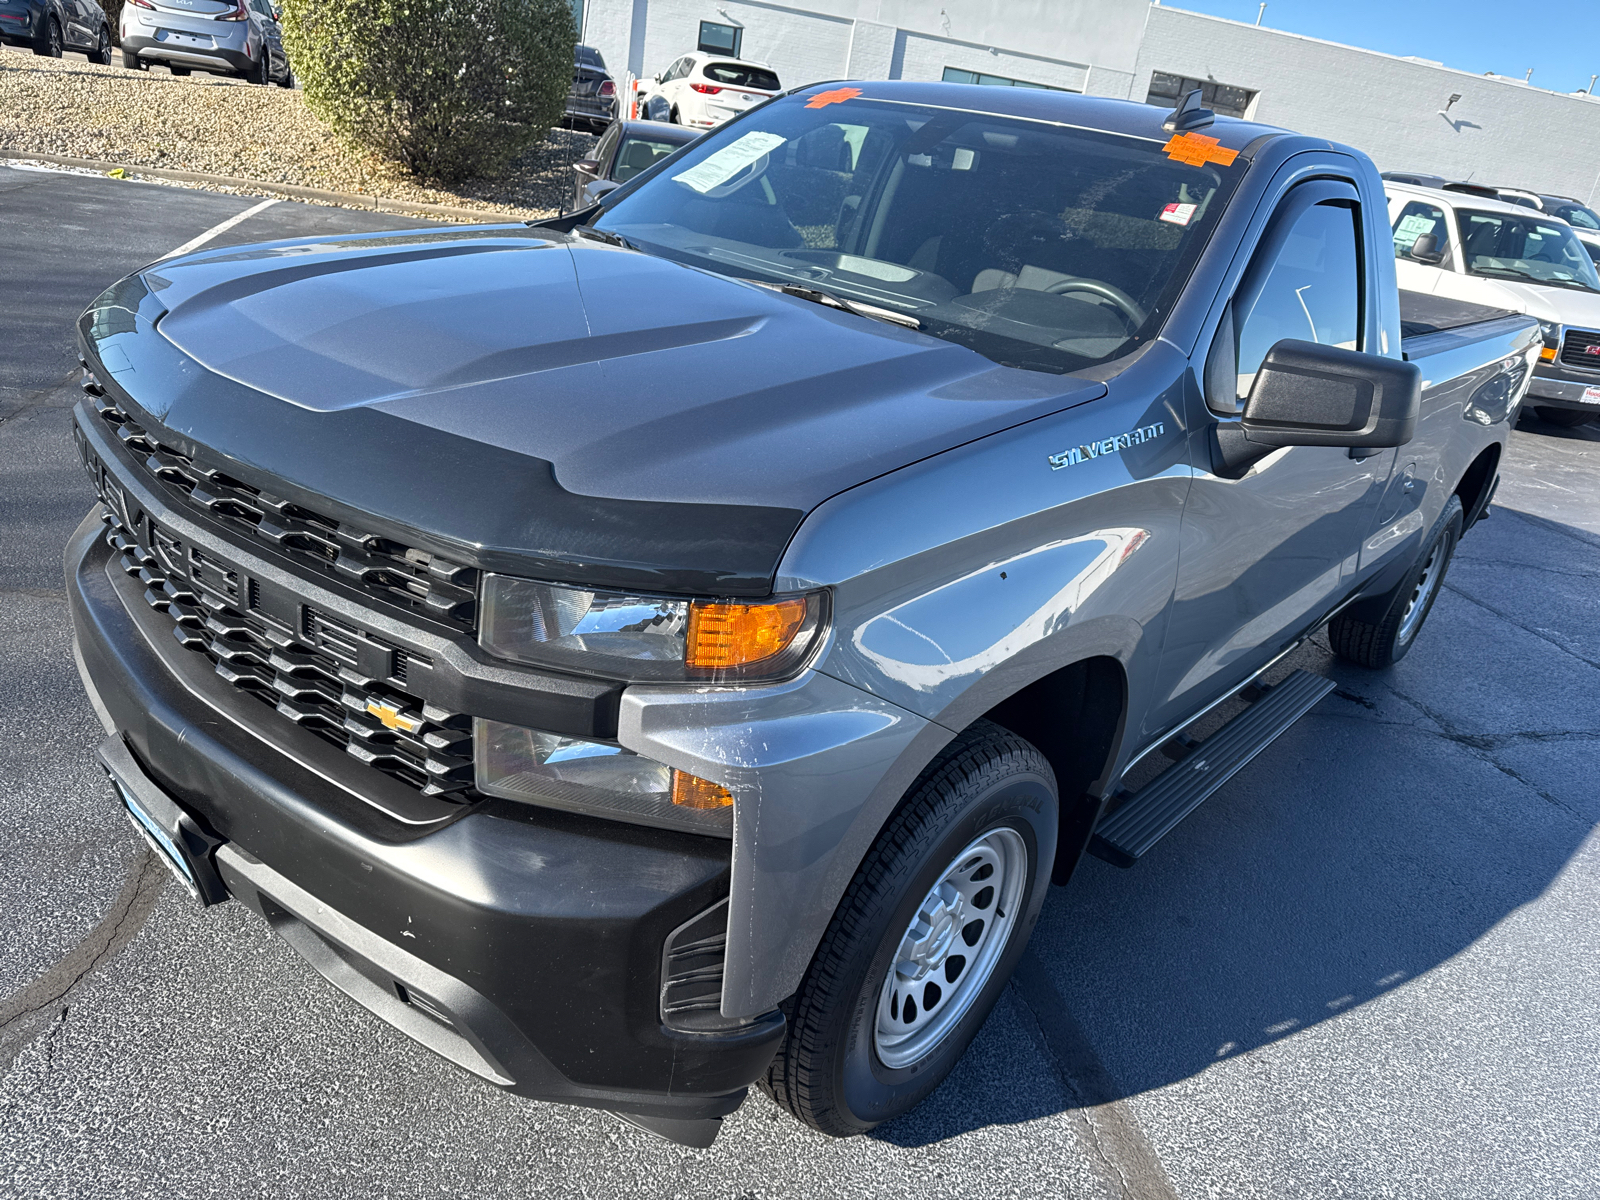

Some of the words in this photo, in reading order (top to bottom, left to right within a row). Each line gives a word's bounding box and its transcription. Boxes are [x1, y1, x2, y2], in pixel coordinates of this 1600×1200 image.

[1048, 421, 1166, 471] SILVERADO
[74, 421, 434, 688] CHEVROLET
[973, 793, 1045, 832] GENERAL
